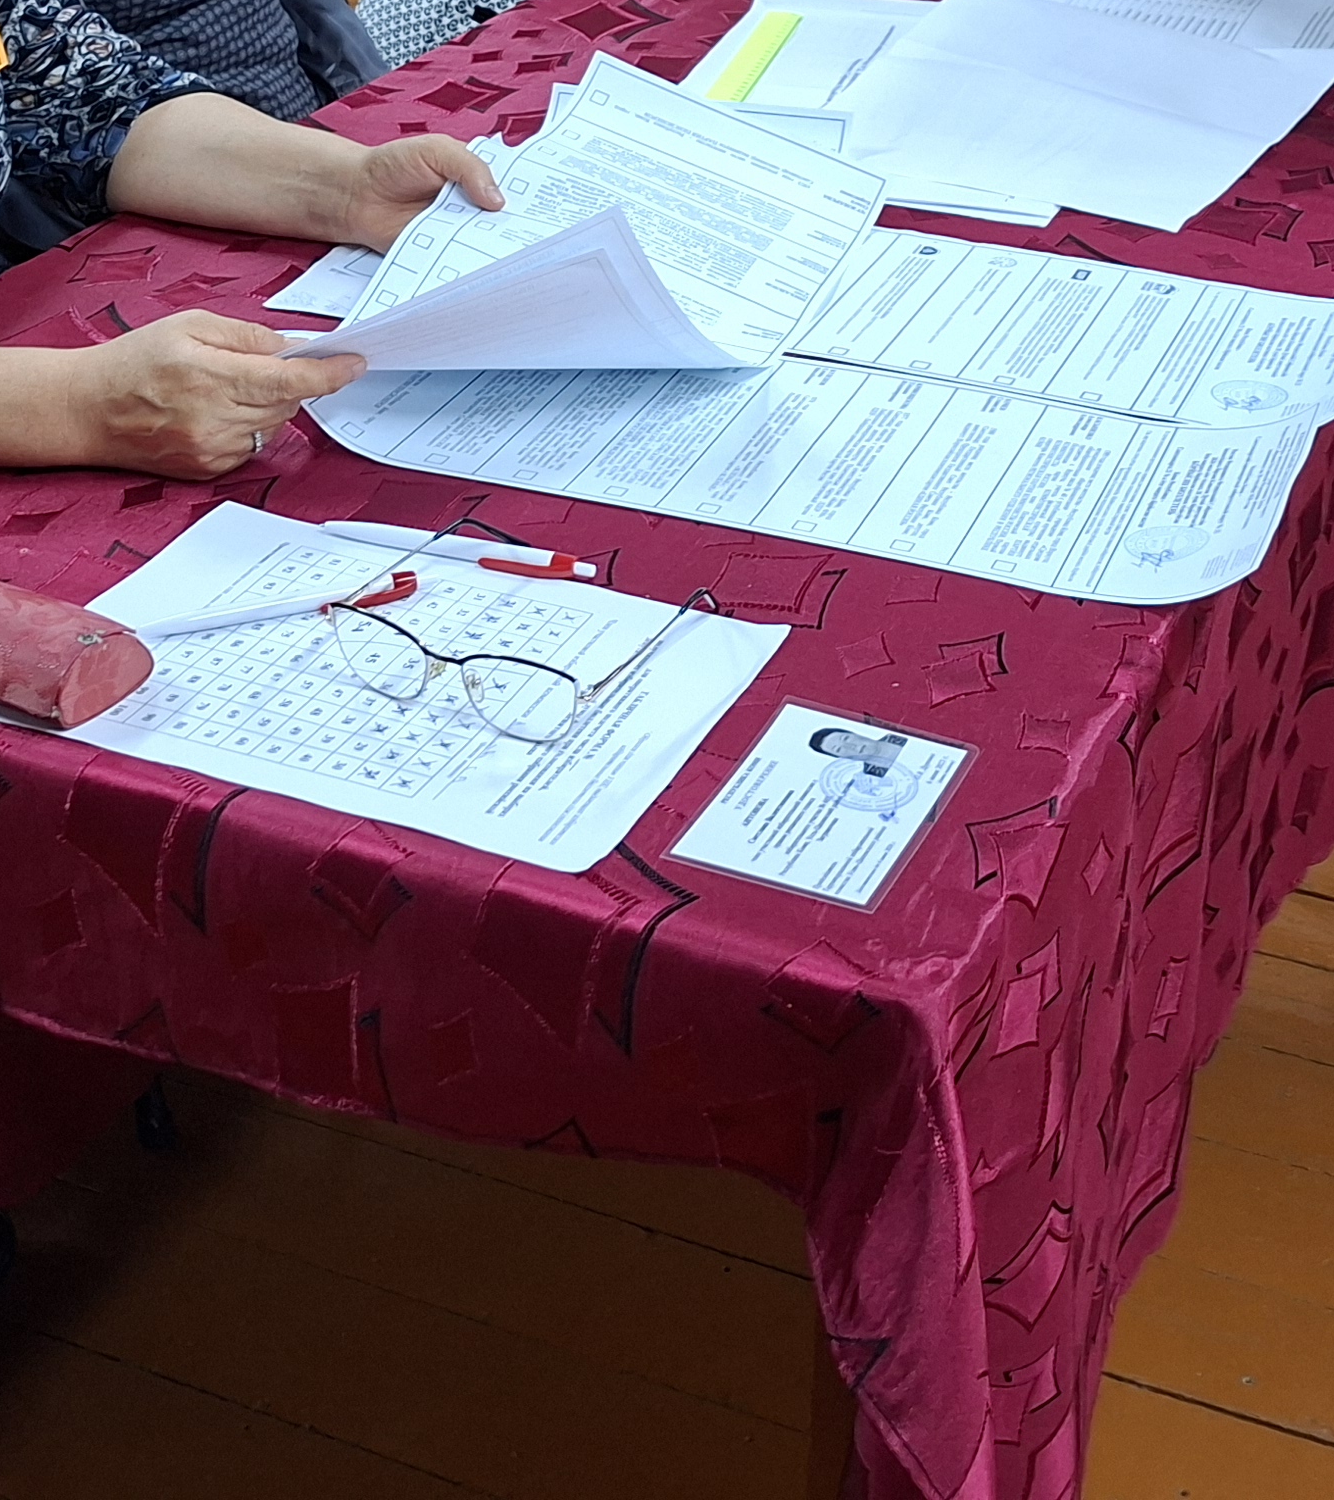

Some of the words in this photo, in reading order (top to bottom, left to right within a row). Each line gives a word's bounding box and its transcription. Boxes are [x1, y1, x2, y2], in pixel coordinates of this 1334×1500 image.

[263, 582, 276, 590] 93
[473, 593, 486, 601] 31
[251, 621, 265, 630] 85
[351, 621, 372, 632] 54
[439, 625, 452, 633] 33
[311, 637, 324, 646] 65
[210, 657, 223, 666] 87
[290, 654, 304, 663] 66
[319, 662, 334, 670] 56
[402, 658, 420, 669] 35
[157, 668, 172, 676] 98
[240, 666, 254, 674] 77
[187, 675, 202, 683] 88
[270, 673, 283, 682] 67
[300, 680, 314, 690] 57
[165, 694, 179, 702] 89
[248, 691, 262, 699] 68
[332, 689, 343, 698] 47
[196, 702, 211, 710] 79
[278, 698, 293, 707] 58
[362, 697, 376, 706] 37
[309, 708, 323, 716] 48
[611, 691, 649, 728] ТАБЛИЧНАЯ
[227, 710, 240, 719] 69
[257, 717, 271, 727] 59
[341, 715, 356, 725] 38
[172, 721, 188, 729] 80
[203, 730, 219, 738] 70
[289, 726, 302, 735] 49
[235, 737, 249, 745] 60
[321, 734, 336, 743] 39
[590, 729, 615, 752] ФОРМА
[266, 744, 282, 753] 50
[353, 742, 368, 751] 29
[299, 754, 312, 762] 40
[331, 760, 347, 770] 30
[734, 760, 779, 810] УДОСТОВЕРЕНИЕ
